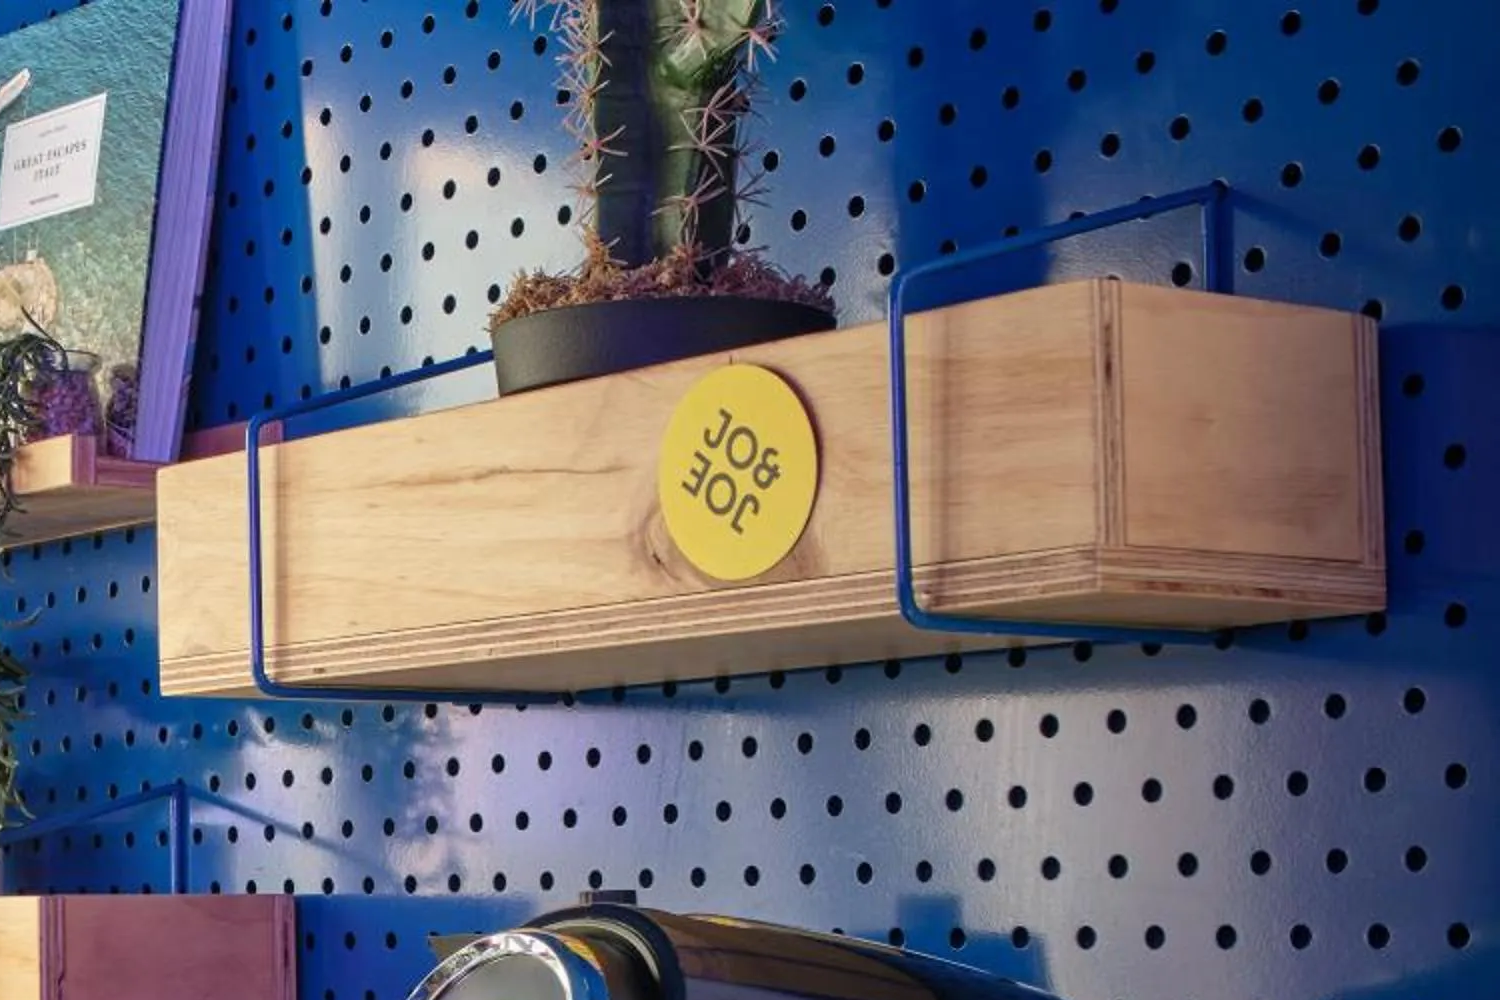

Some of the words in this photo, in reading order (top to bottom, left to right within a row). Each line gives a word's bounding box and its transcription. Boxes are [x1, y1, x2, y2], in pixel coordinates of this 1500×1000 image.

[13, 152, 44, 171] GREAT
[47, 139, 88, 160] ESCAPES
[33, 164, 60, 181] ITALY
[681, 450, 761, 535] JOE
